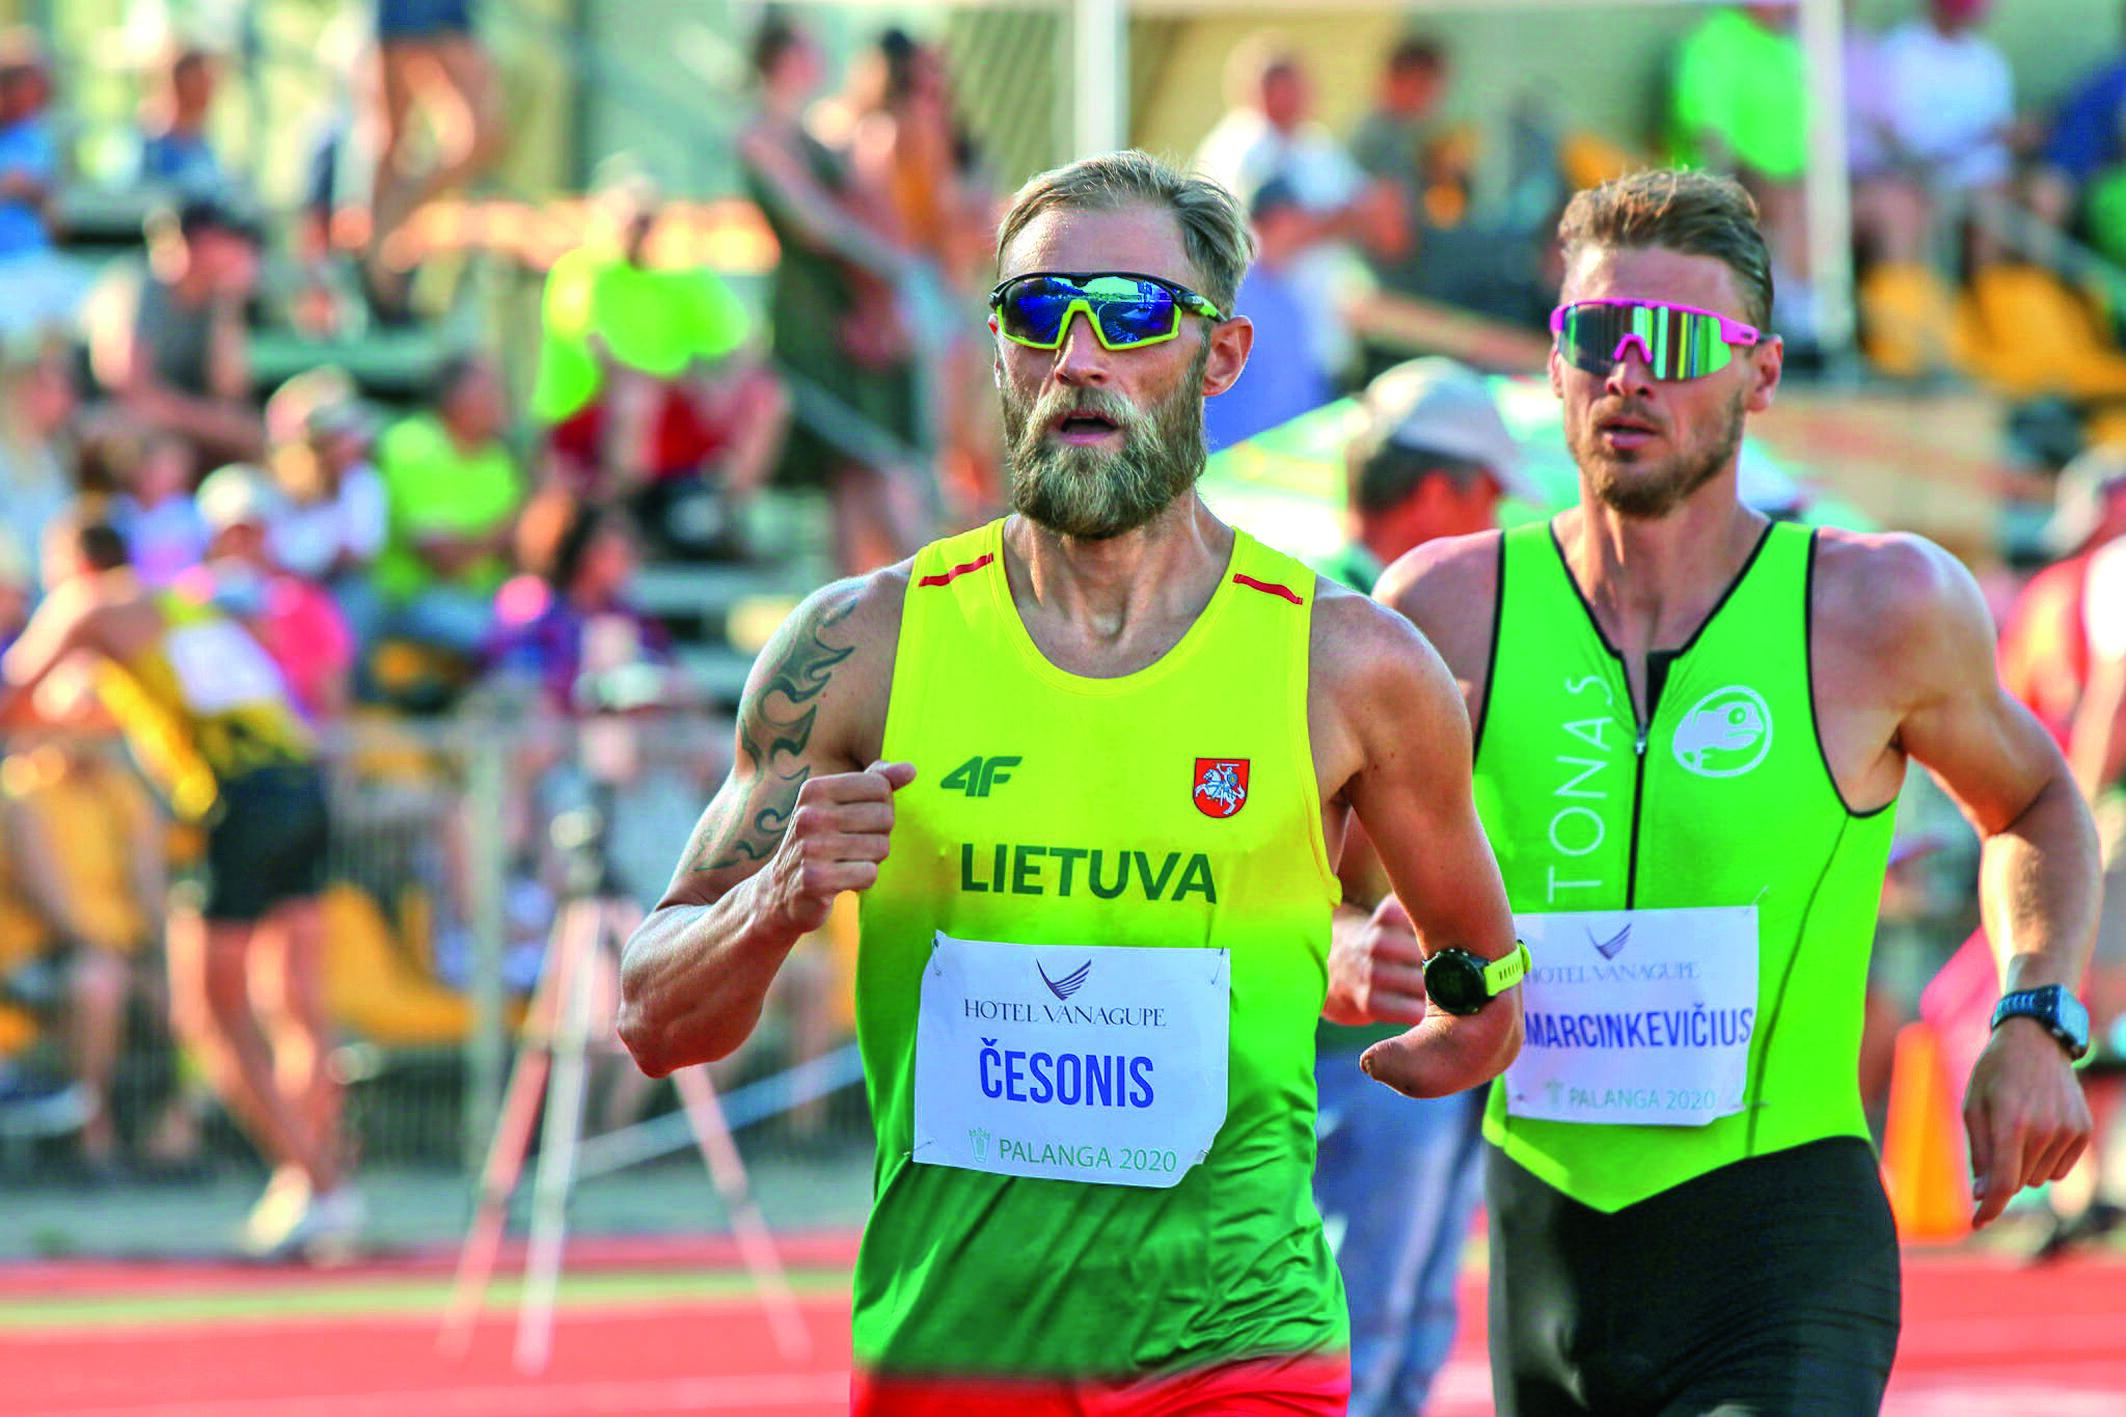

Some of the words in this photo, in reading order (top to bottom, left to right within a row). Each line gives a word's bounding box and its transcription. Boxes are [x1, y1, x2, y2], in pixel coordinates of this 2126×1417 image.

[940, 755, 1023, 797] 4F
[1547, 675, 1613, 904] TONAS
[961, 843, 1217, 905] LIETUVA
[964, 998, 1039, 1023] HOTEL
[1043, 1004, 1167, 1027] VANAGUPE
[1523, 1002, 1754, 1048] MARCINKEVIČIUS
[979, 1037, 1154, 1108] ČESONIS
[1569, 1087, 1660, 1110] PALANGA
[1665, 1088, 1716, 1111] 2020
[999, 1138, 1112, 1169] PALANGA
[1119, 1148, 1177, 1172] 2020
